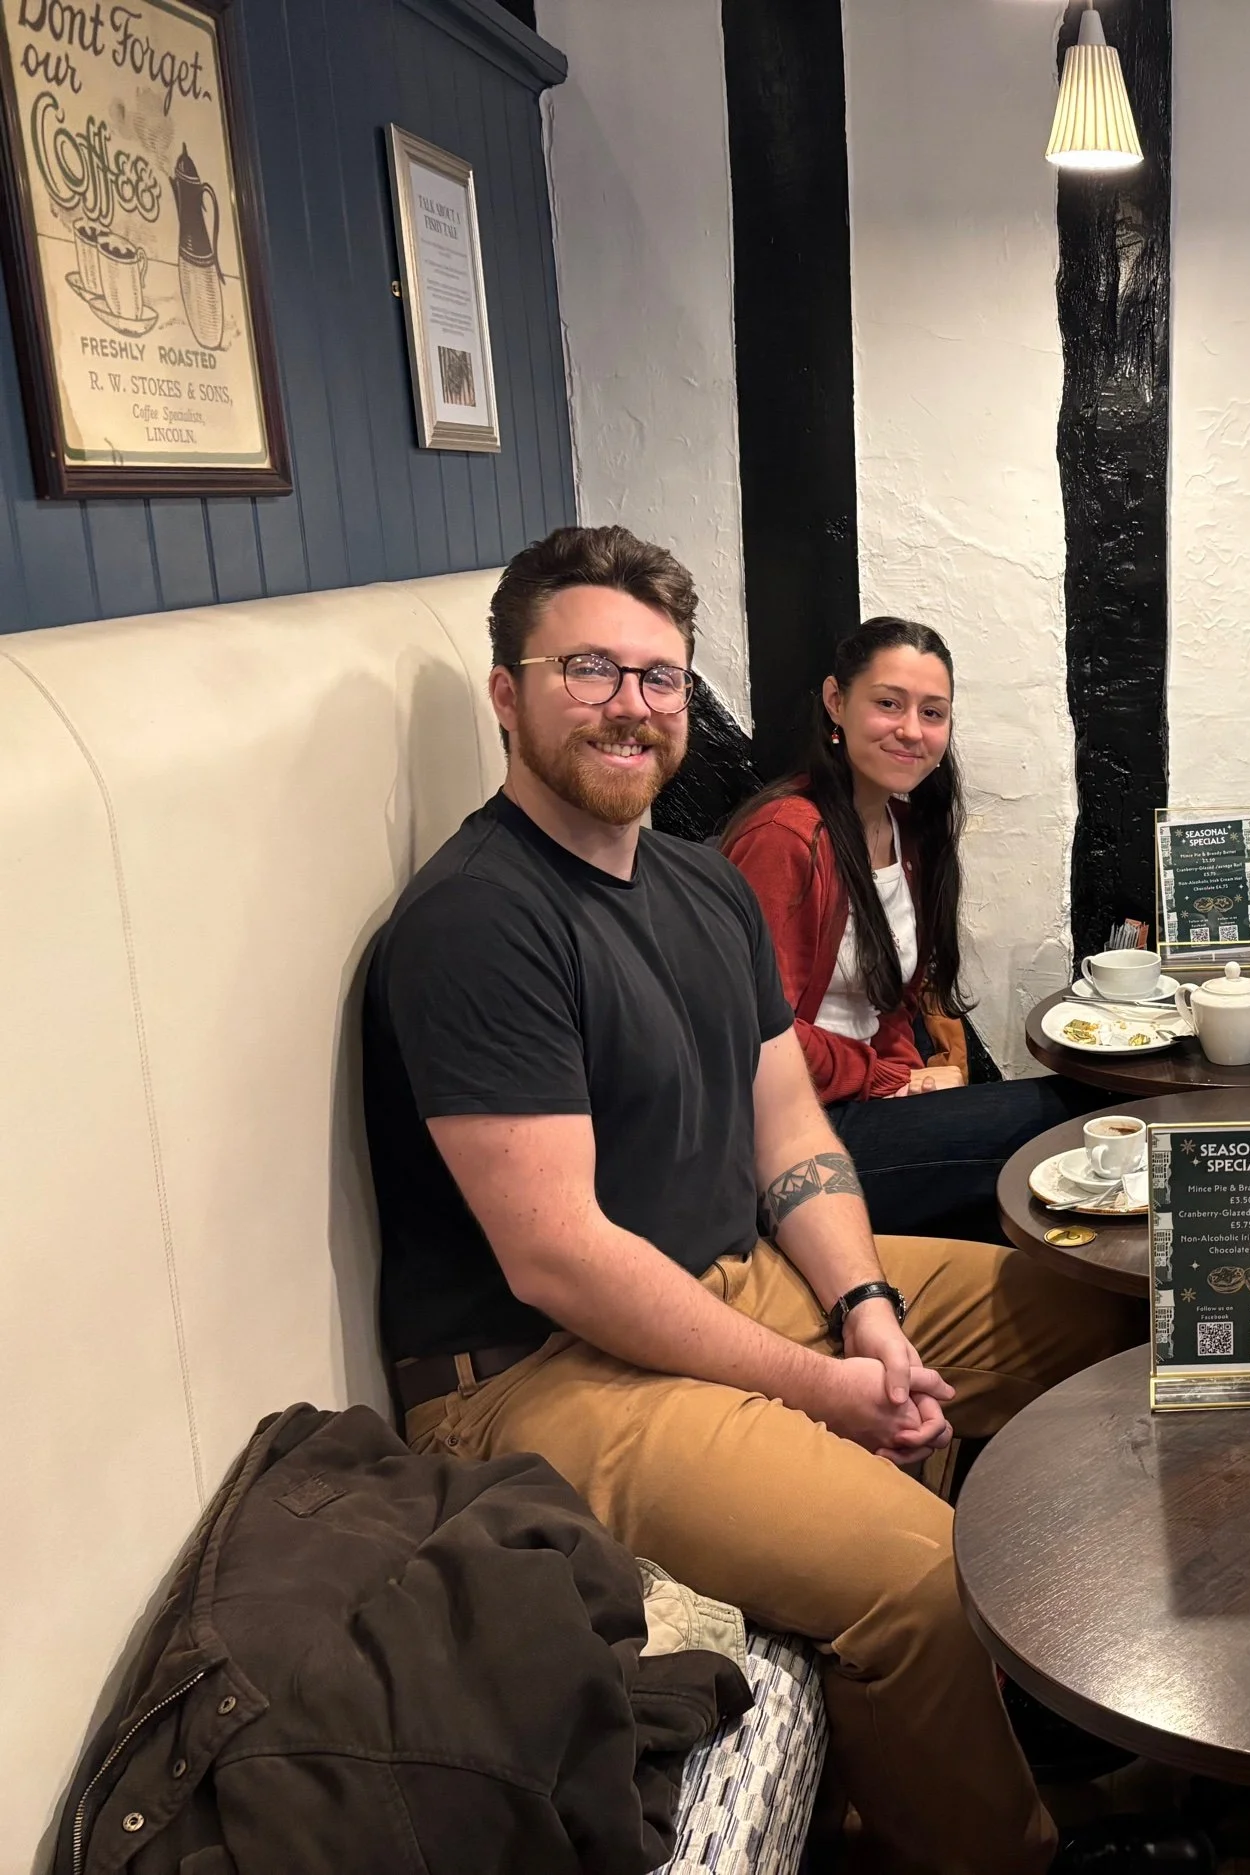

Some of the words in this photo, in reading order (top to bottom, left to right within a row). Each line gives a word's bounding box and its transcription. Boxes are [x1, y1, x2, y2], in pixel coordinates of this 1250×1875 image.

[21, 43, 82, 94] our
[30, 91, 162, 228] Coffee
[80, 336, 146, 361] FRESHLY
[158, 345, 217, 370] ROASTED
[88, 370, 104, 392] R.
[108, 372, 126, 393] W.
[131, 375, 182, 399] STOKES
[187, 382, 196, 400] &
[199, 383, 234, 407] SONS,
[132, 403, 159, 422] Coffee
[1185, 828, 1229, 839] SEASONAL
[1189, 836, 1226, 847] SPECIALS
[1214, 1184, 1227, 1192] Pie
[1229, 1184, 1236, 1192] &
[1178, 1208, 1250, 1218] Cranberry-Glazed
[1180, 1234, 1239, 1243] Non-Alcoholic
[1208, 1246, 1250, 1254] Chocolate
